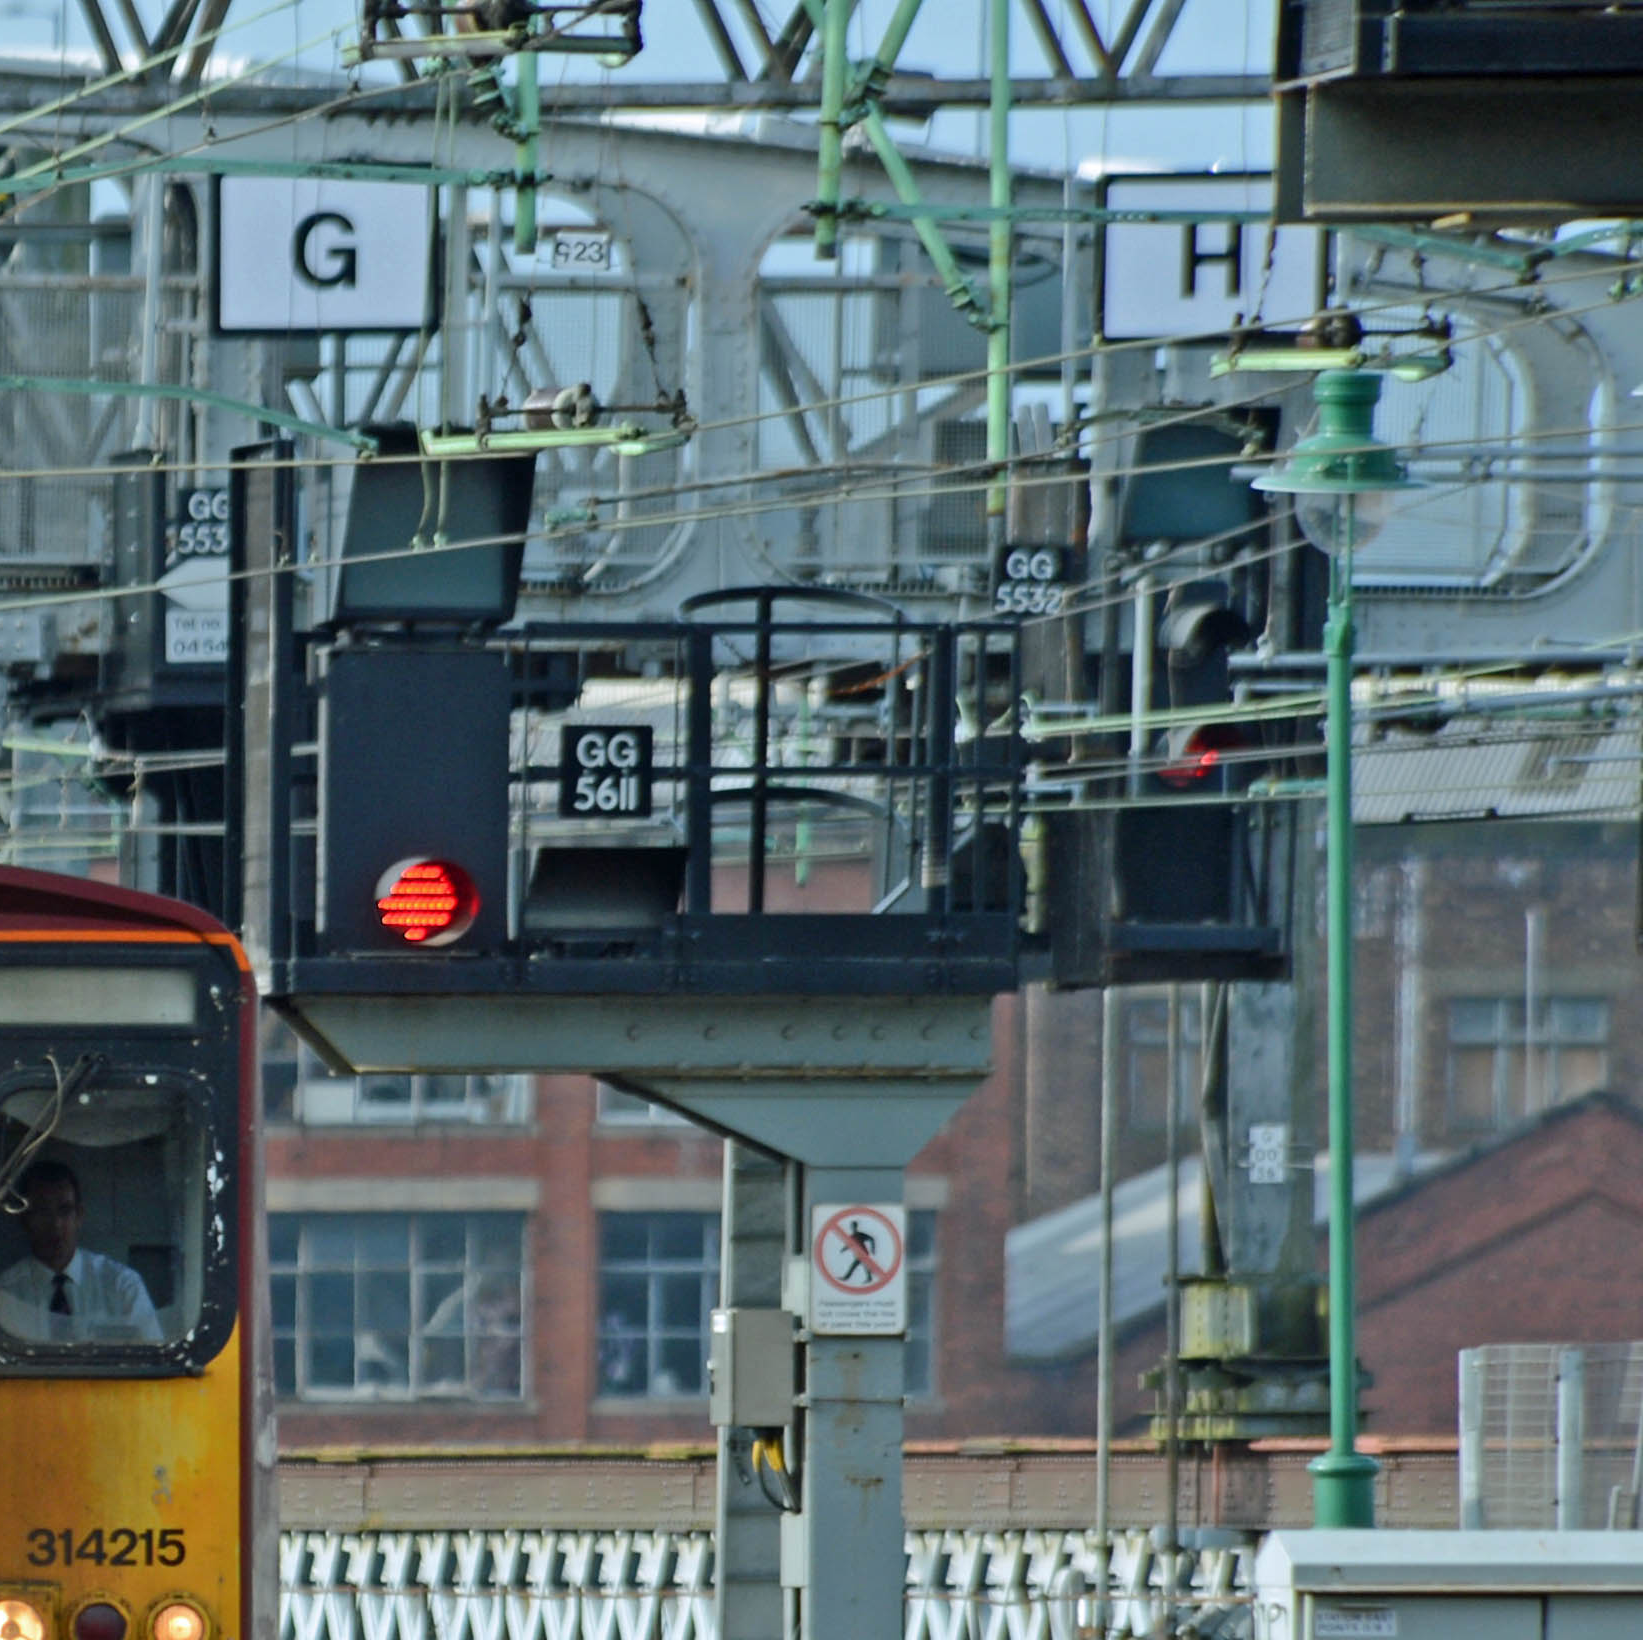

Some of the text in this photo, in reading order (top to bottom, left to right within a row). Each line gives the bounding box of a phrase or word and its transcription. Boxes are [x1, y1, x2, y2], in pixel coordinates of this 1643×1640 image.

[292, 212, 357, 289] G
[1180, 219, 1243, 298] H
[1006, 550, 1054, 580] GG
[995, 584, 1061, 614] 5532
[576, 733, 637, 768] GG
[573, 776, 637, 811] 5611
[26, 1527, 187, 1567] 314215
